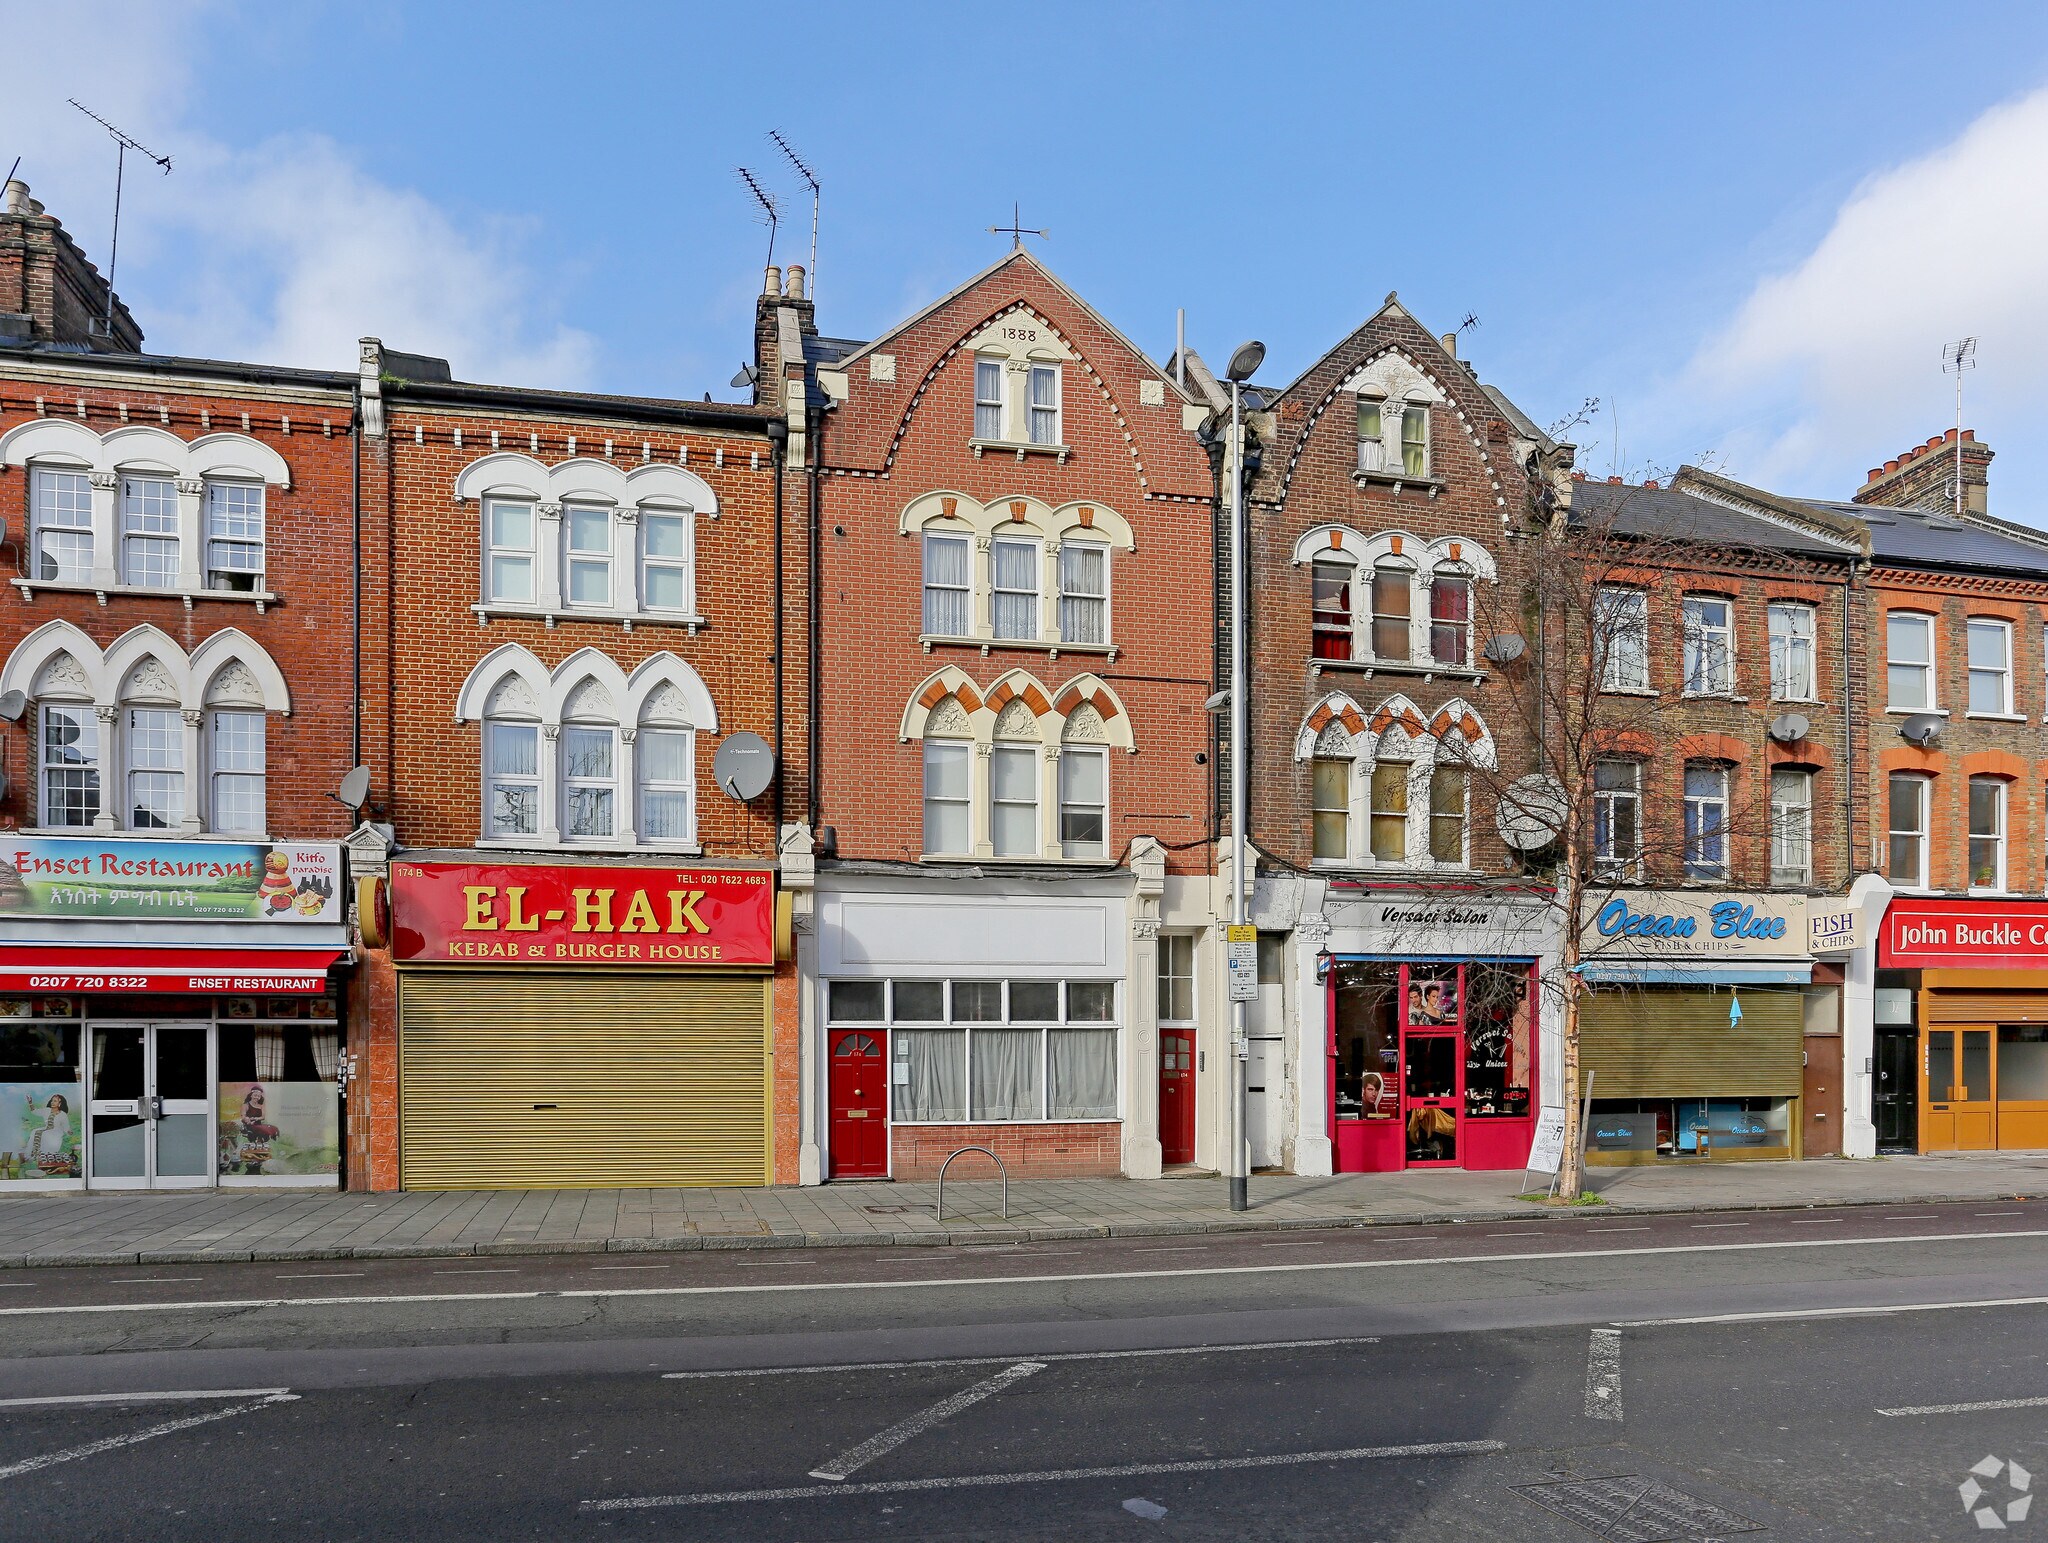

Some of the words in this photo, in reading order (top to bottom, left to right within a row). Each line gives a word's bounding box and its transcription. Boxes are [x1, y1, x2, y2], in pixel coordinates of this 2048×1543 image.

[1002, 328, 1036, 341] 1888
[296, 852, 326, 863] Kitfo
[13, 851, 92, 875] Enset
[99, 853, 253, 878] Restaurant
[292, 866, 333, 874] paradise
[398, 869, 413, 877] 174
[416, 869, 423, 877] B
[677, 875, 698, 883] TEL:
[701, 875, 717, 884] 020
[720, 875, 742, 885] 7622
[745, 876, 767, 885] 4683
[109, 889, 162, 906] ምግብ
[168, 889, 199, 907] ቤት
[462, 885, 711, 934] EL-HAK
[1381, 907, 1440, 923] Versaci
[1443, 908, 1488, 924] Salon
[1597, 898, 1698, 937] Ocean
[1709, 901, 1787, 940] Blue
[1812, 913, 1854, 934] FISH
[1900, 921, 1947, 950] John
[1955, 923, 2022, 946] Buckle
[1654, 941, 1680, 950] FISH
[1685, 942, 1691, 950] &
[1694, 941, 1729, 950] CHIPS
[1812, 939, 1821, 949] &
[1823, 935, 1854, 948] CHIPS
[449, 942, 519, 957] KEBAB
[527, 944, 545, 957] &
[556, 943, 642, 958] BURGER
[649, 944, 722, 960] HOUSE
[29, 976, 70, 988] 0207
[74, 977, 105, 988] 720
[108, 977, 148, 988] 8322
[188, 978, 231, 989] ENSET
[233, 978, 318, 990] RESTAURANT
[1503, 1092, 1527, 1100] OPEN
[1596, 1129, 1616, 1137] Ocean
[1617, 1129, 1633, 1137] Blue
[1731, 1126, 1749, 1134] Ocean
[1751, 1125, 1766, 1134] Blue
